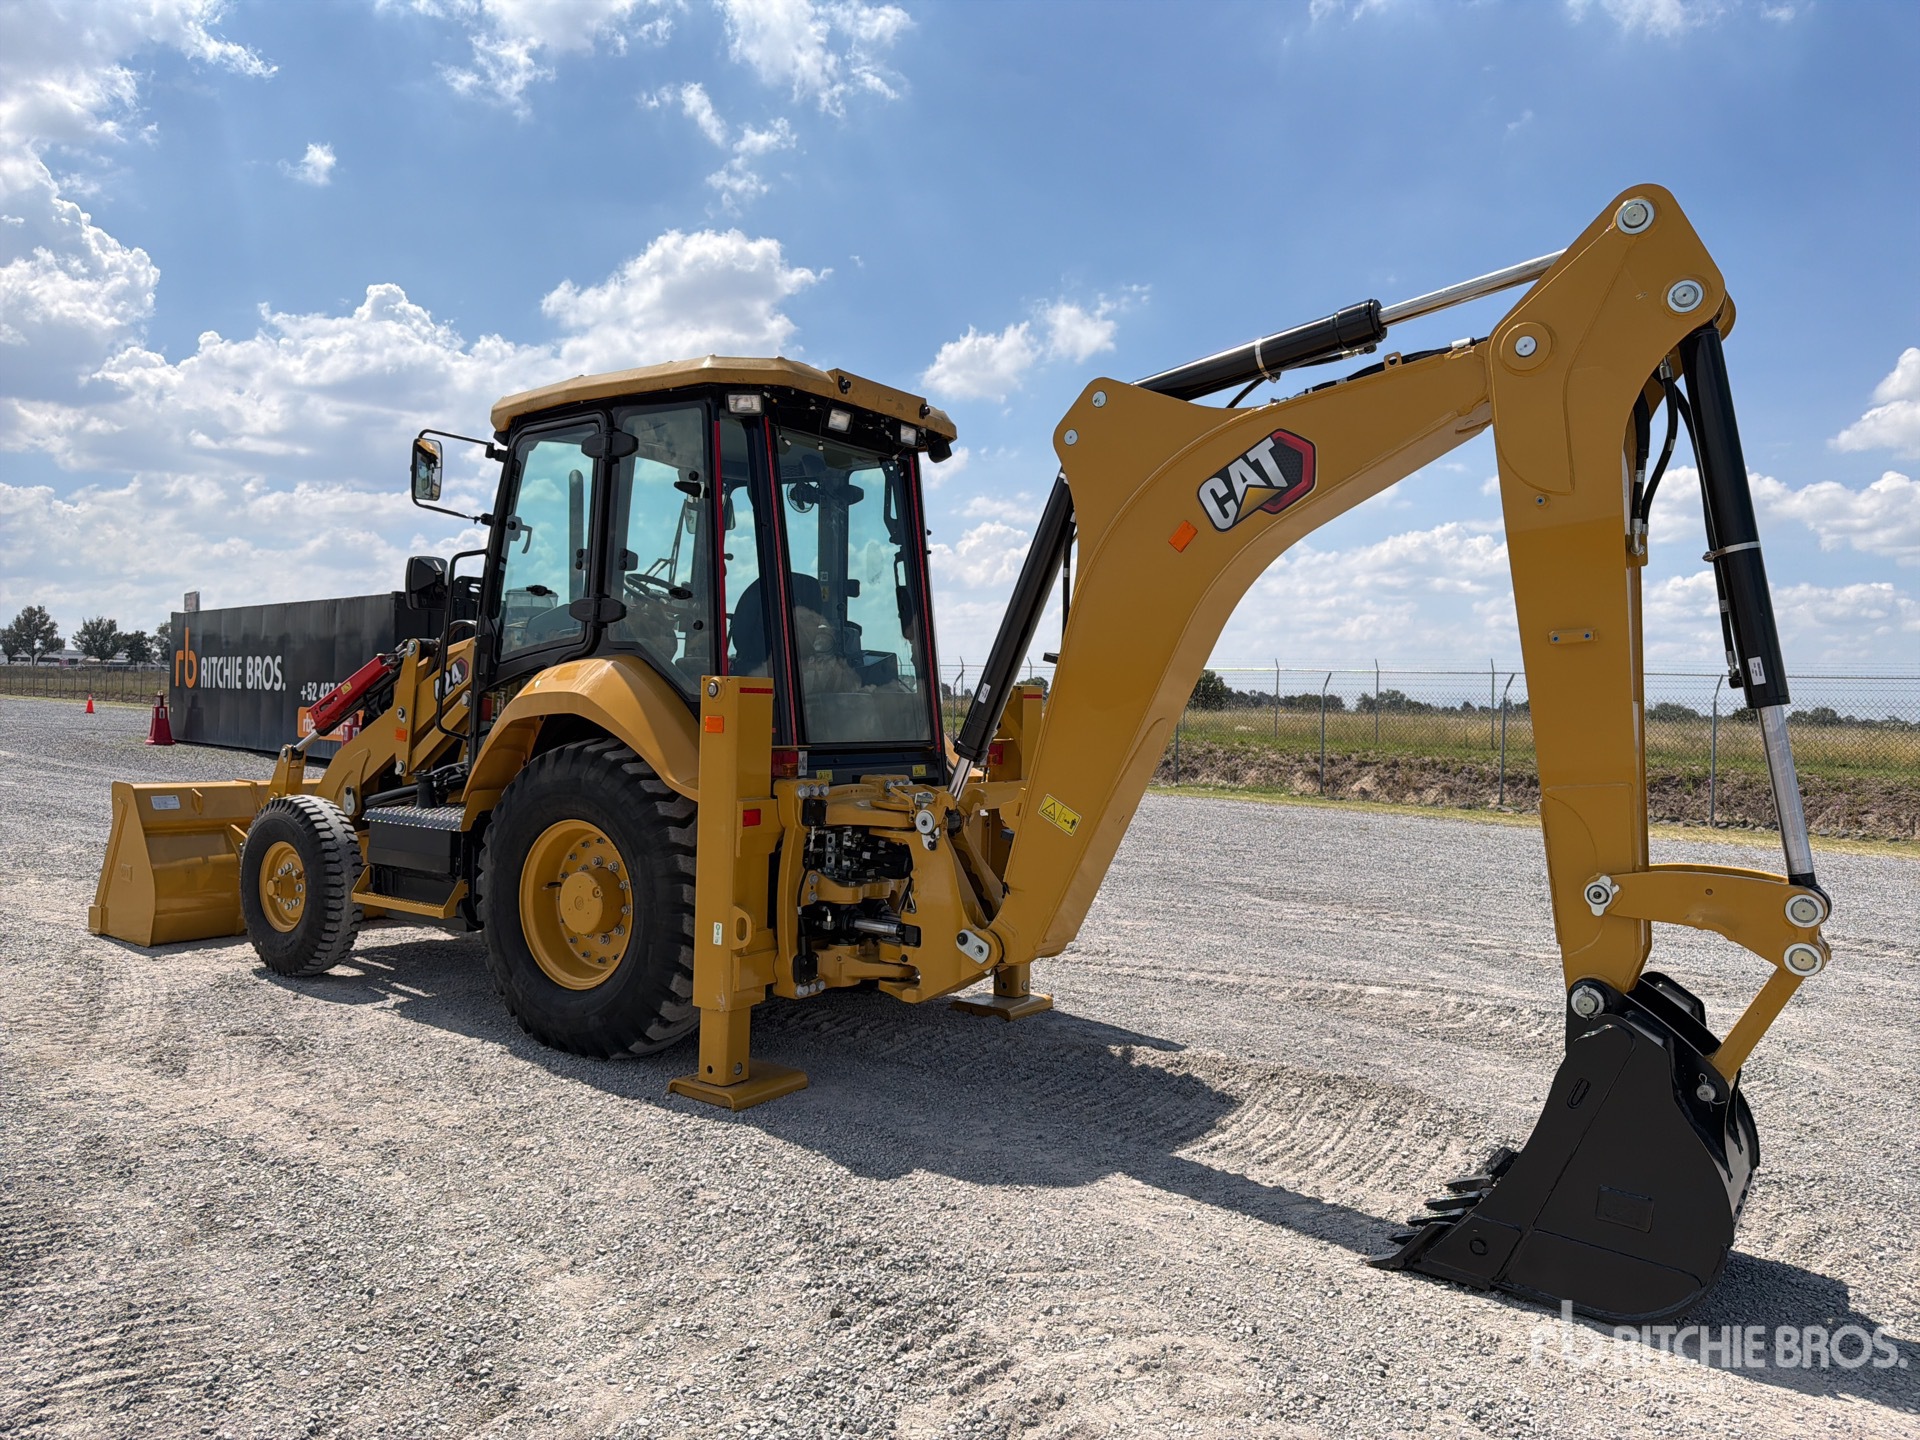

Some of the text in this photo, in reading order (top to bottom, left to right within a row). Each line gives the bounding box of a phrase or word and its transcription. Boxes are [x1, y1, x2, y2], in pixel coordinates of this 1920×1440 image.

[1199, 437, 1288, 530] CAT
[175, 627, 286, 691] rb RITCHIE BROS.
[301, 682, 317, 701] +52
